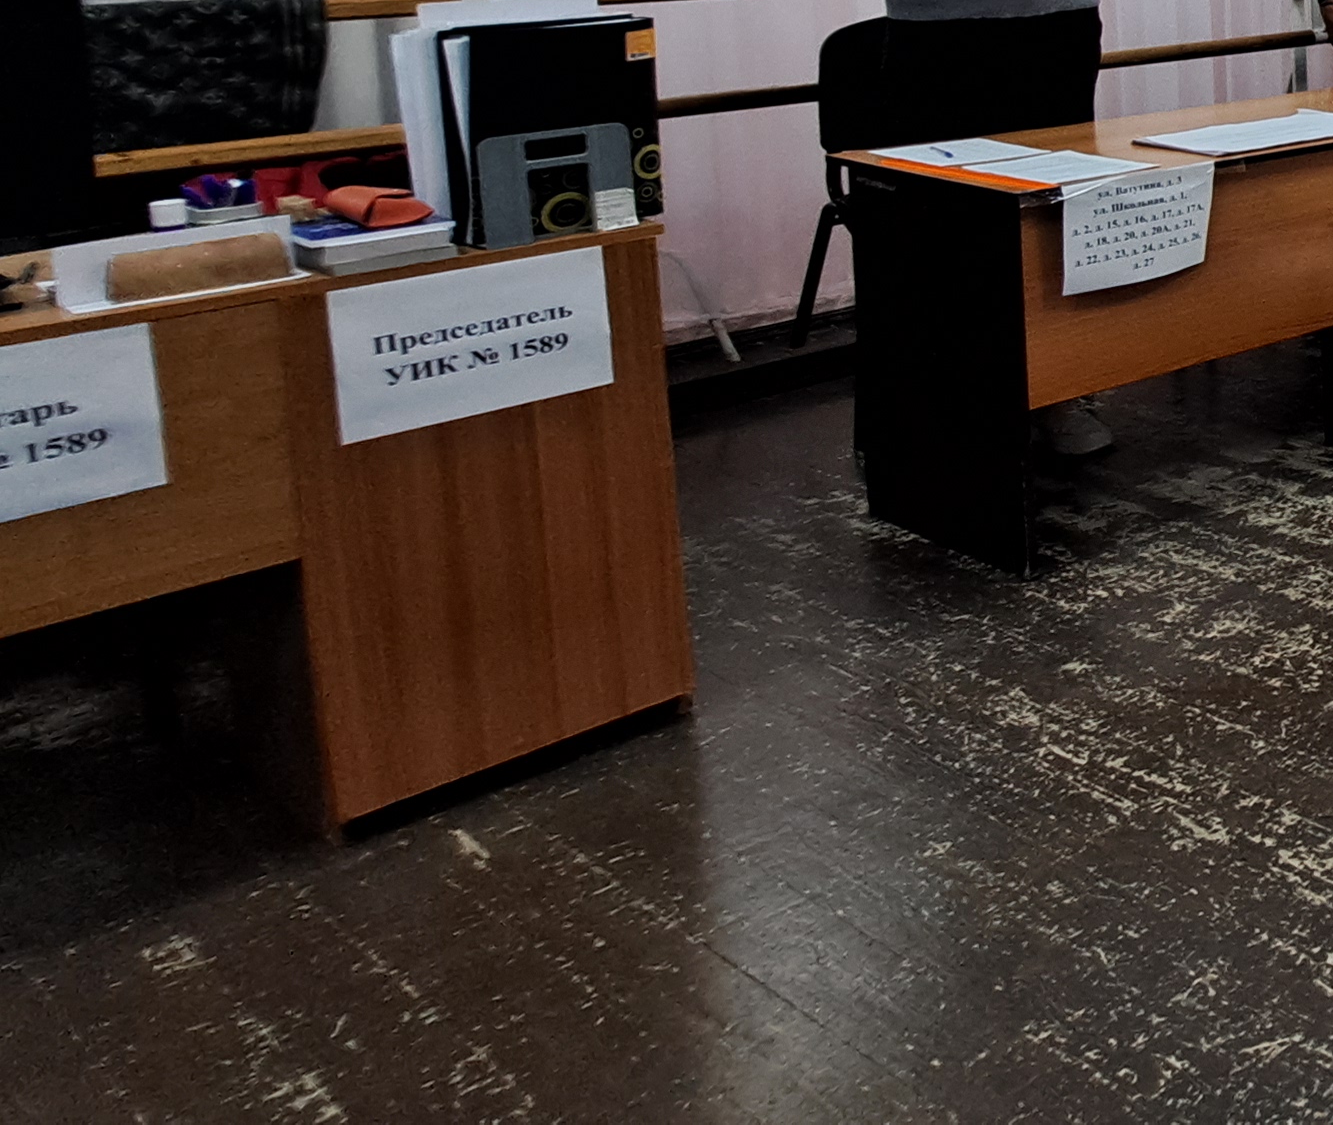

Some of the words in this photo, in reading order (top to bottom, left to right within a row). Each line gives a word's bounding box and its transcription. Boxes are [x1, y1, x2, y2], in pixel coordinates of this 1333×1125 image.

[1144, 257, 1154, 267] 27
[373, 305, 574, 355] Председатель
[385, 354, 460, 387] УИК
[466, 347, 501, 370] №
[508, 332, 570, 362] 1589
[25, 427, 108, 465] 1589
